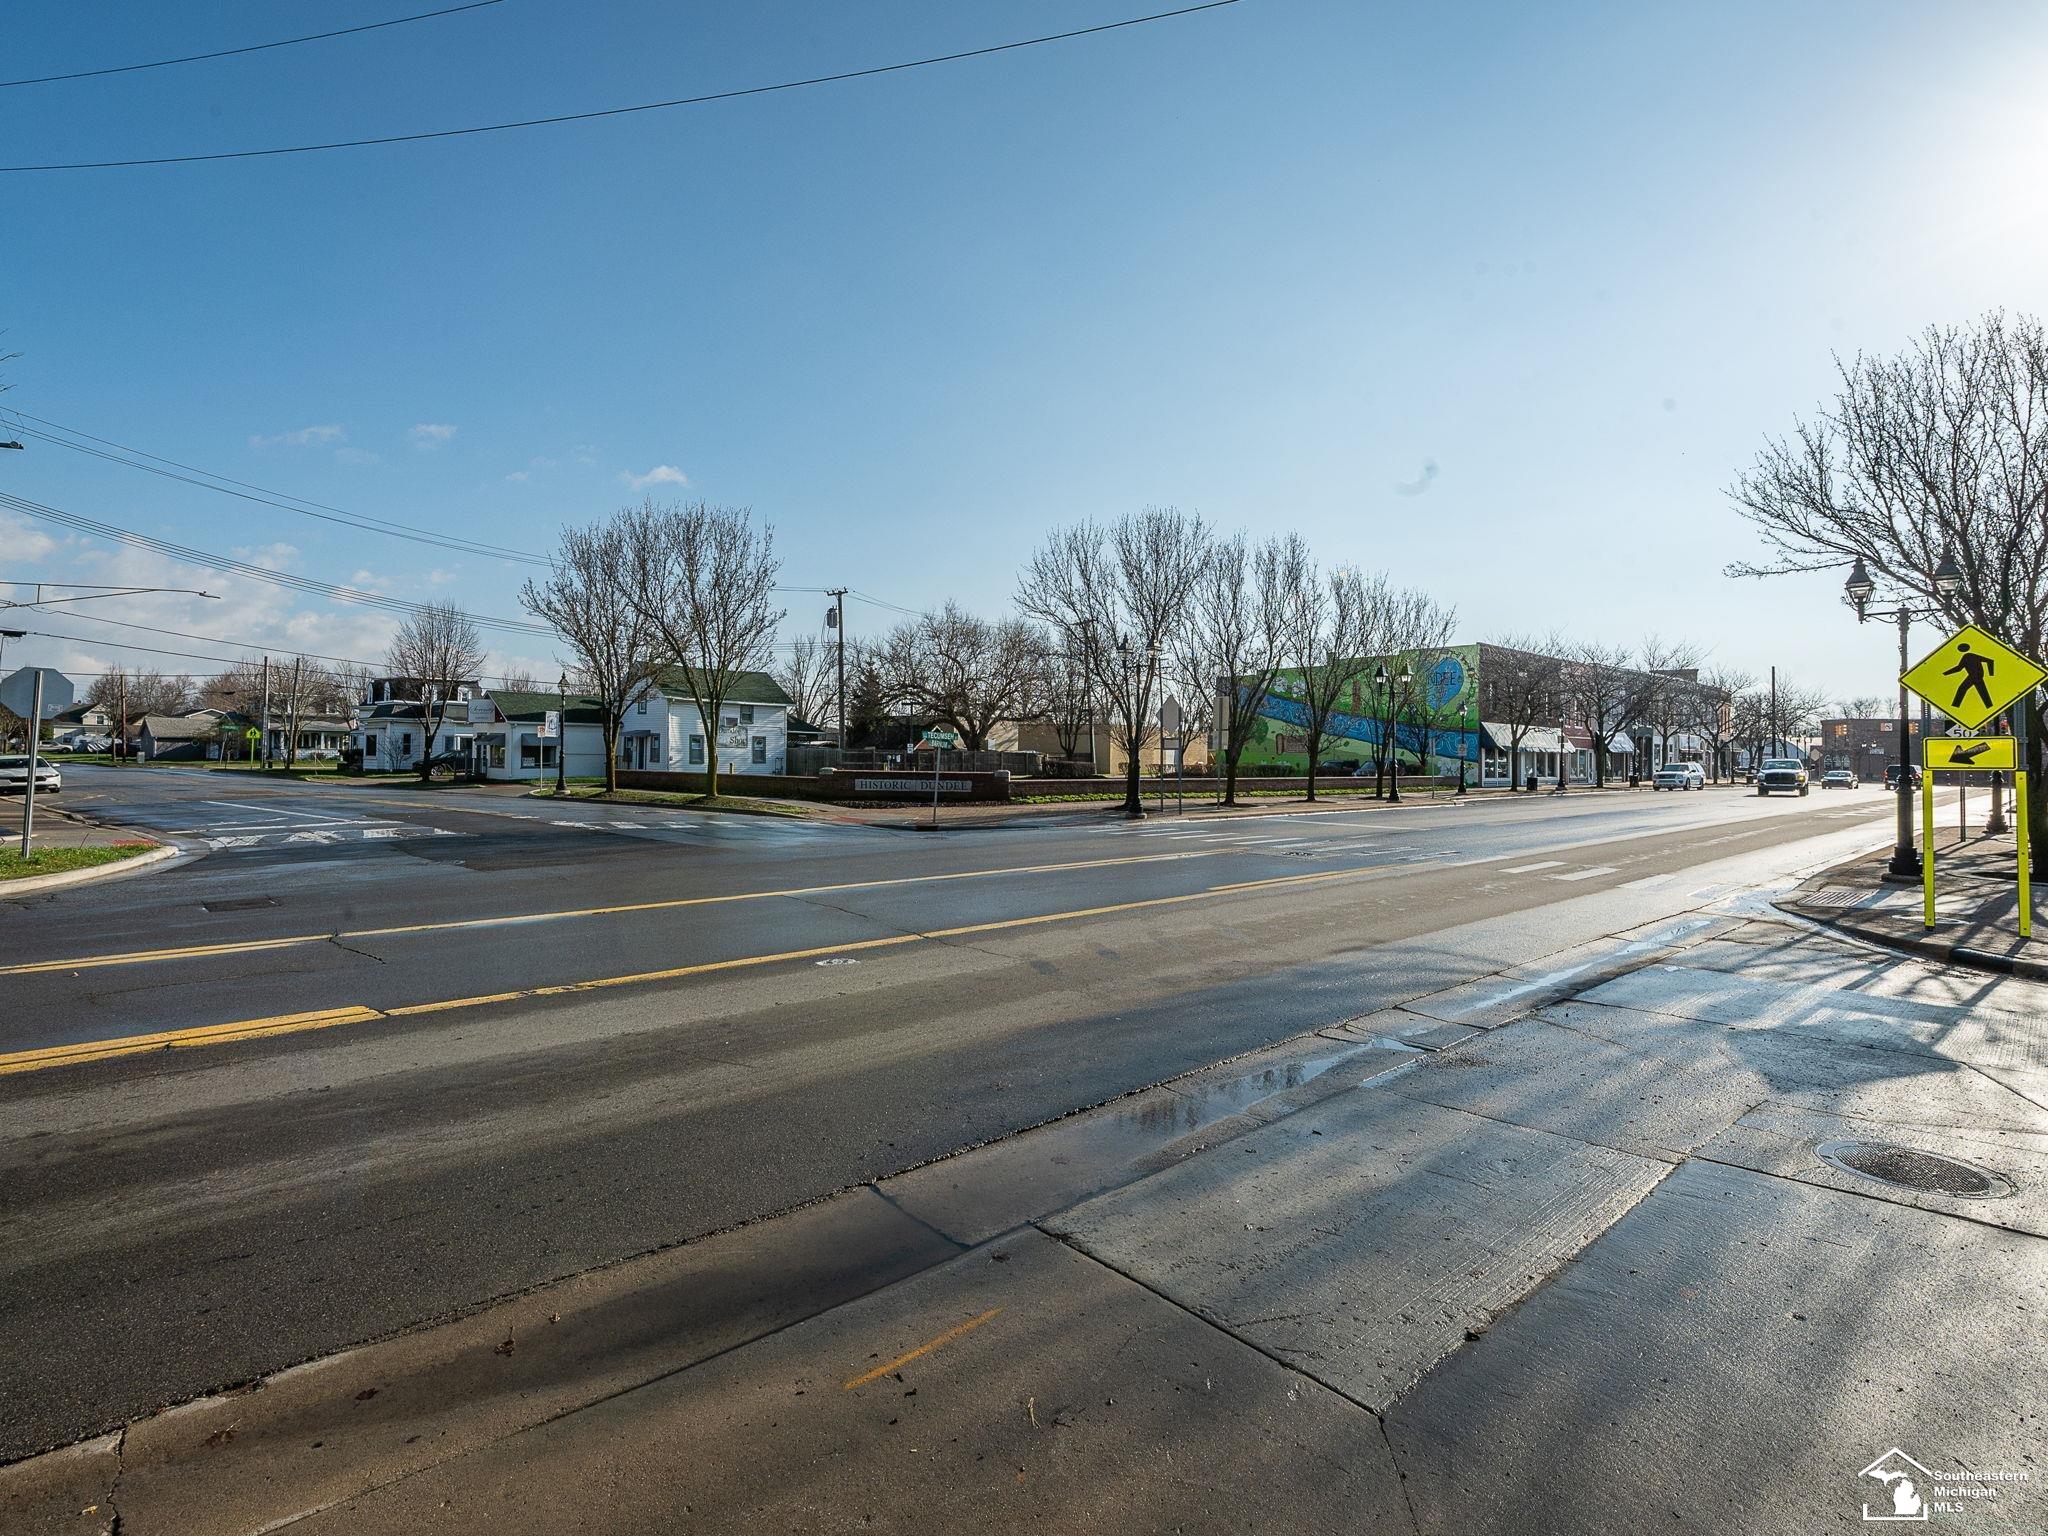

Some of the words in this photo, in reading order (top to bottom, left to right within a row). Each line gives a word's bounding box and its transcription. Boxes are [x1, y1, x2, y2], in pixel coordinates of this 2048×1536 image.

[927, 732, 954, 740] TECUMSEH
[1953, 729, 1972, 738] 50
[860, 780, 911, 790] HISTORIC
[920, 781, 969, 791] DUNDEE
